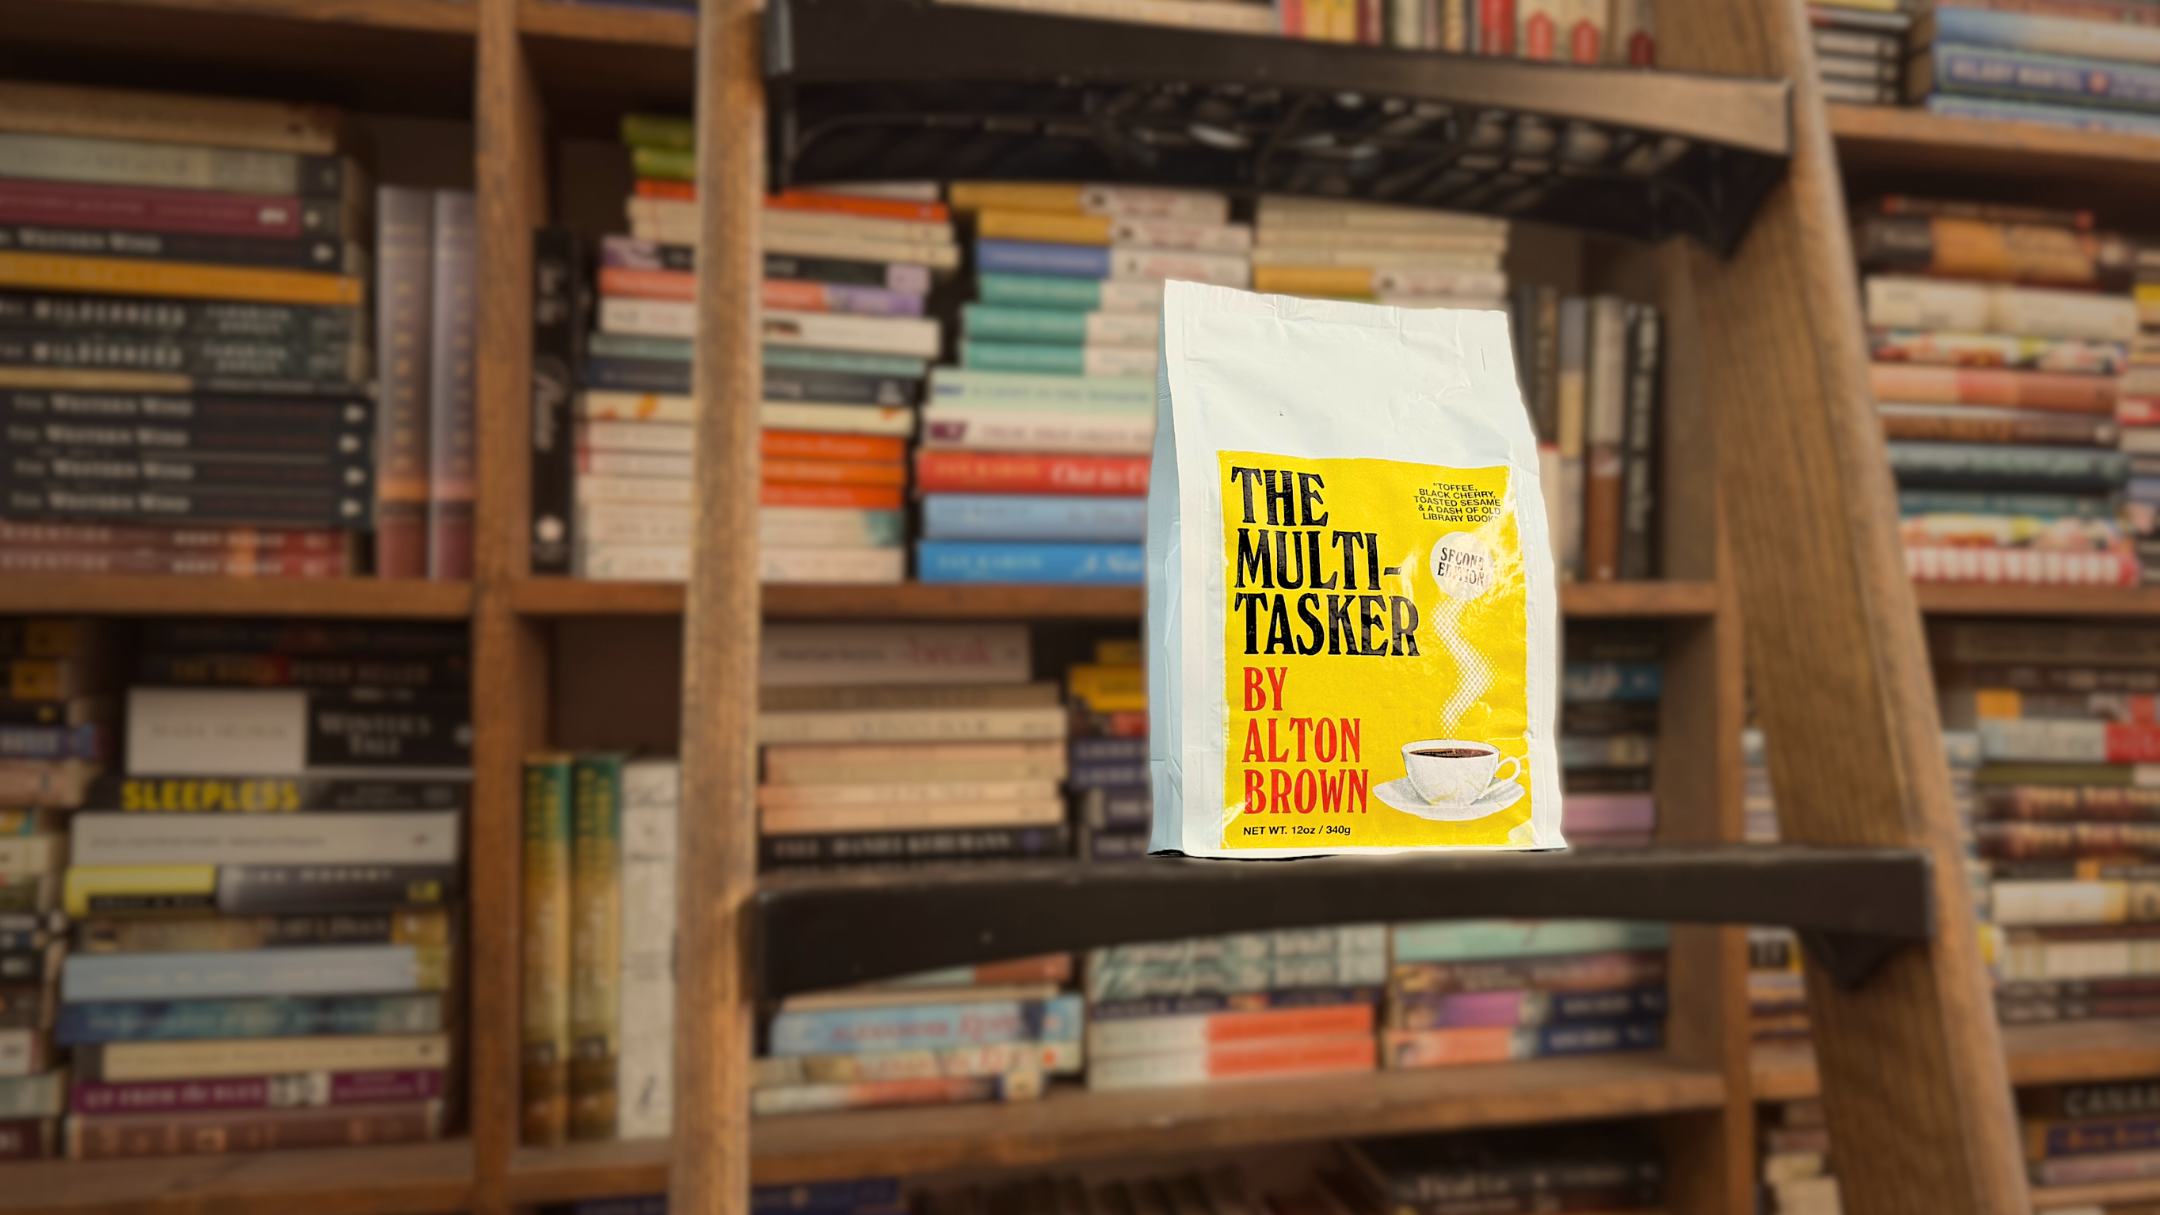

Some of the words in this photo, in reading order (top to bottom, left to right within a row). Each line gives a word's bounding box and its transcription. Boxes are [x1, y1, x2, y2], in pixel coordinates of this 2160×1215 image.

[1231, 466, 1328, 527] THE
[1413, 495, 1458, 507] TOASTED
[1460, 498, 1501, 507] SESAME
[1418, 488, 1451, 499] BLACK
[1452, 490, 1496, 500] CHERRY,
[1418, 504, 1425, 512] &
[1427, 504, 1434, 513] A
[1436, 506, 1463, 515] DASH
[1465, 506, 1479, 515] OF
[1481, 506, 1501, 515] OLD
[1422, 512, 1463, 522] LIBRARY
[1234, 527, 1401, 591] MULTI-
[1234, 592, 1420, 657] TASKER
[1243, 667, 1288, 712] BY
[1242, 717, 1360, 763] ALTON
[121, 780, 299, 812] SLEEPLESS
[1243, 769, 1369, 815] BROWN
[1243, 826, 1266, 837] NET
[1267, 826, 1288, 837] WT.
[1291, 826, 1316, 836] 12oz
[1325, 825, 1351, 837] 340g
